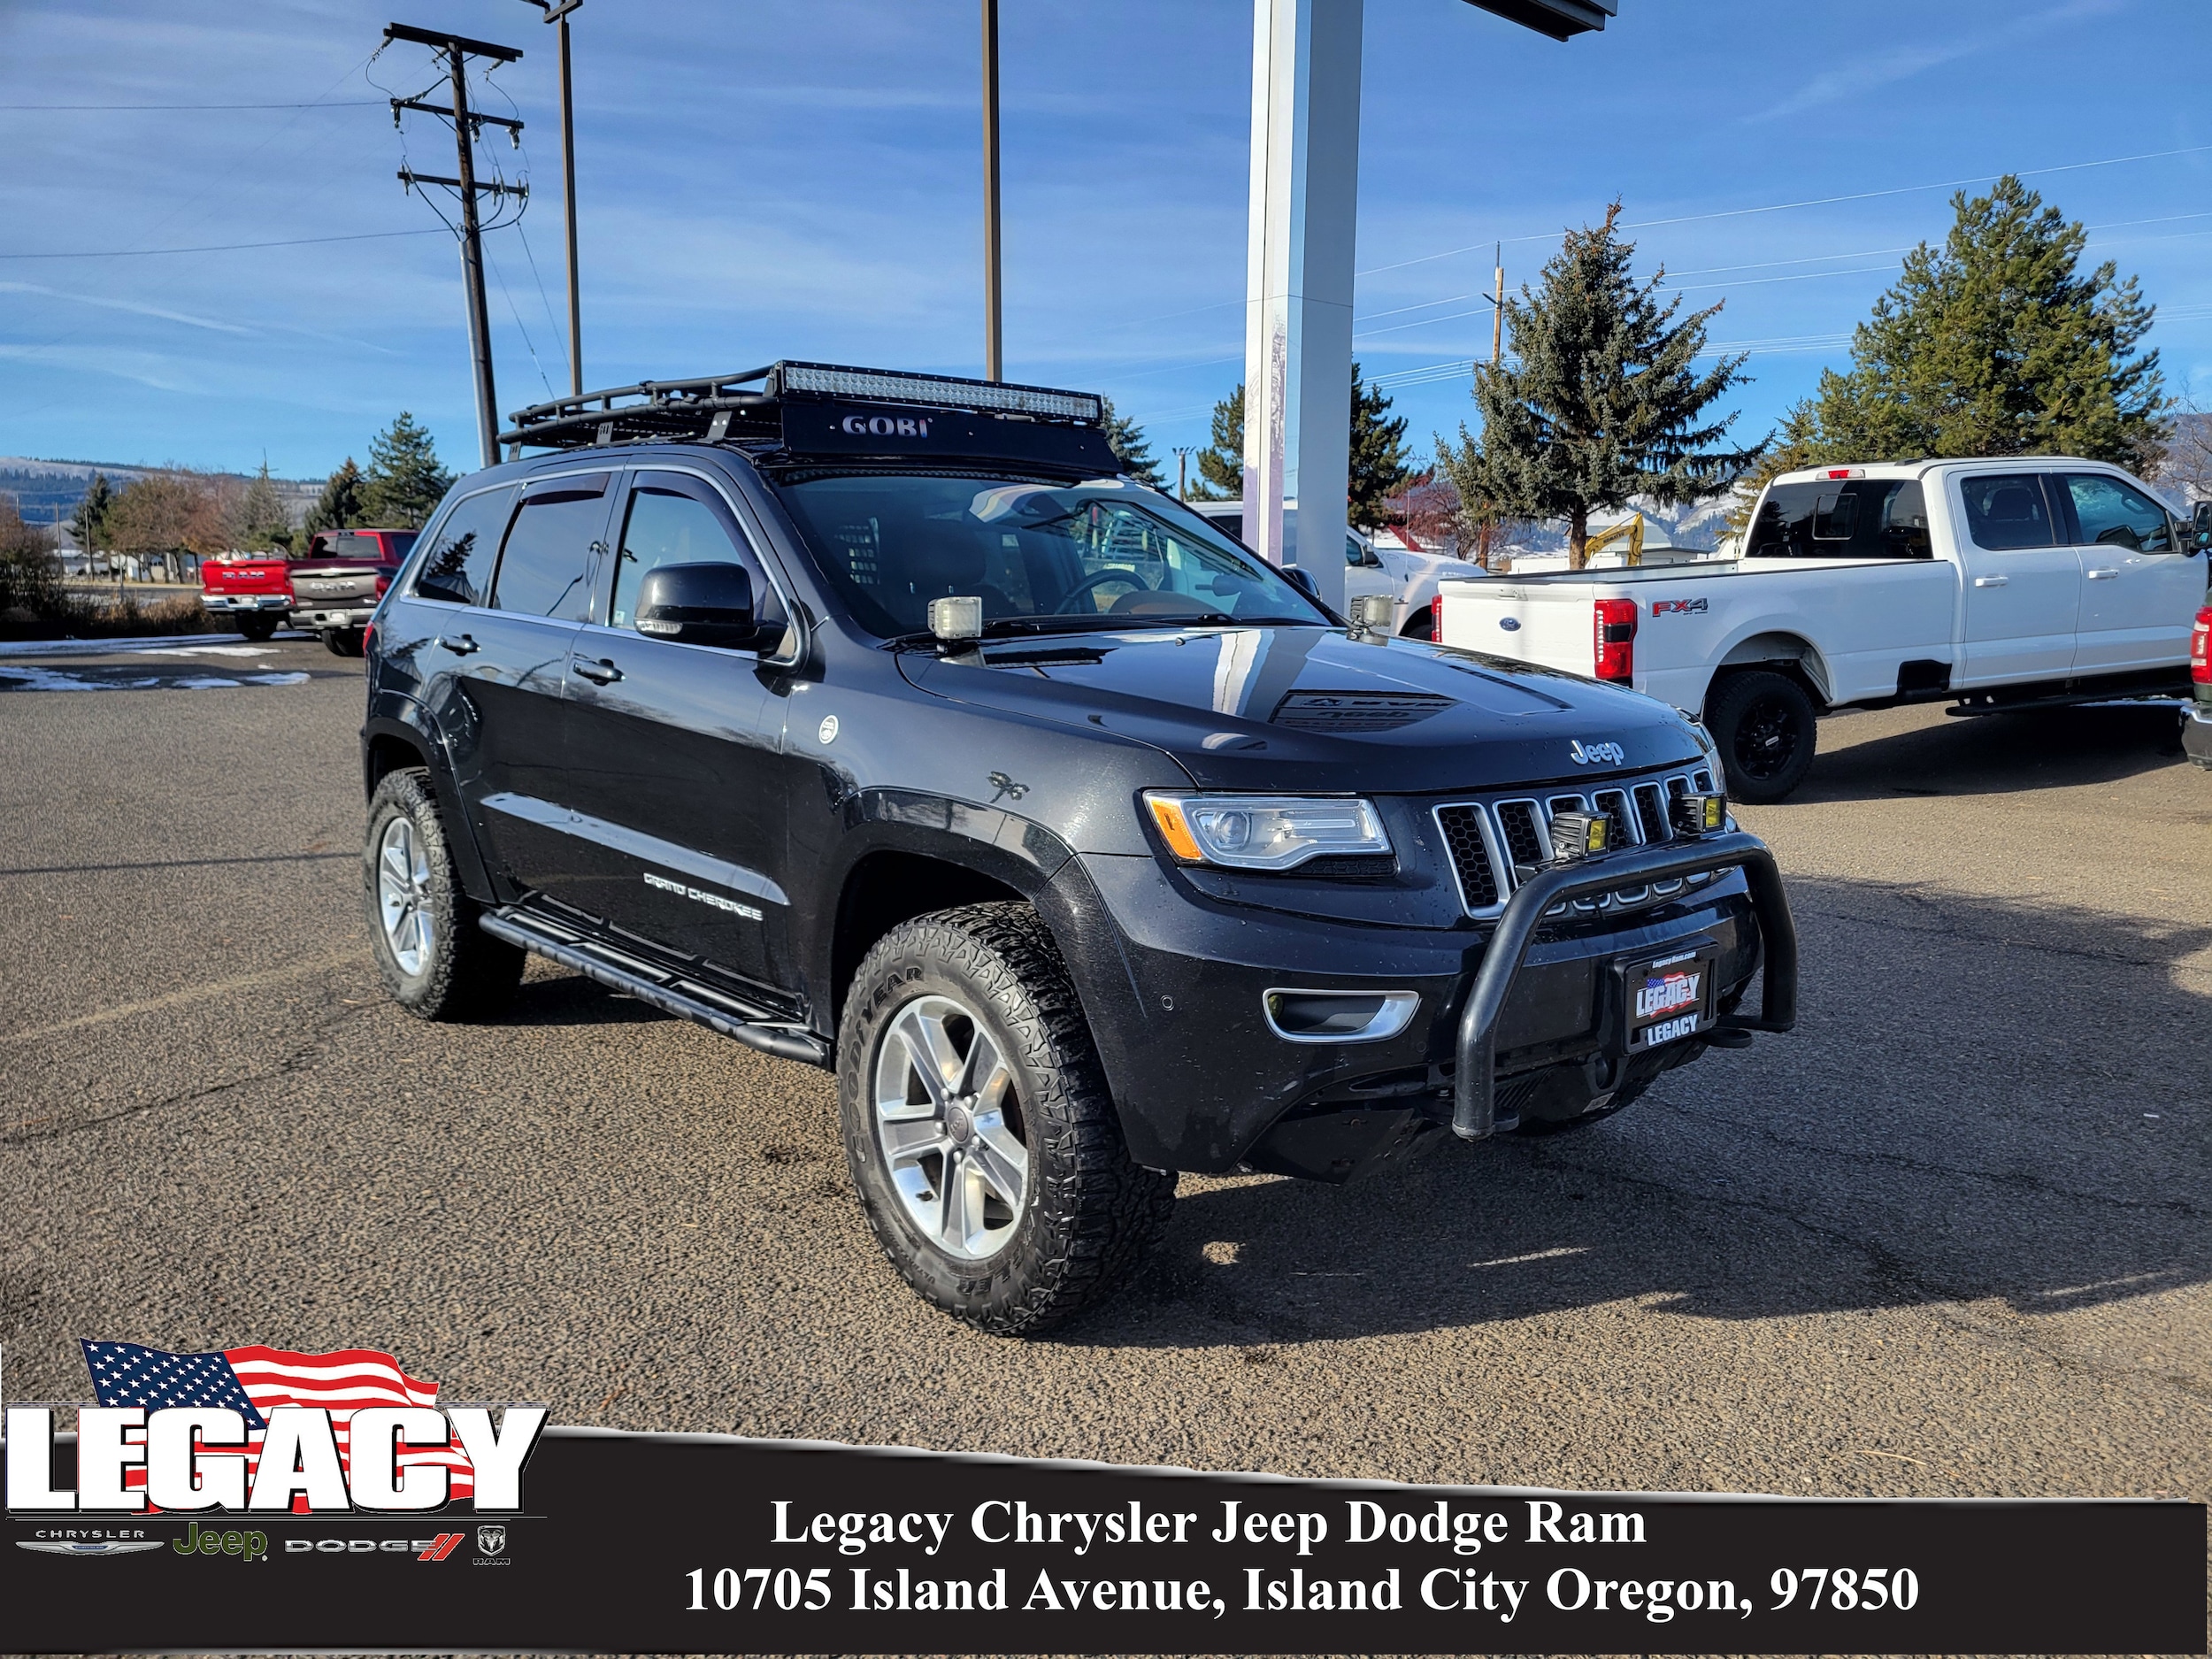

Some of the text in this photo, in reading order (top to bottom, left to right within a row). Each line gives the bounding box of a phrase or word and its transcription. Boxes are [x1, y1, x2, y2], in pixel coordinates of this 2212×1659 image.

[841, 415, 927, 439] GOBI
[221, 571, 265, 580] RAM
[1652, 597, 1709, 618] FX4
[1570, 739, 1624, 767] Jeep
[643, 872, 764, 922] GRAND CHEROKEE
[1636, 974, 1701, 1017] LEGACY
[1647, 1014, 1698, 1046] LEGACY
[847, 966, 923, 1164] GOODYEAR
